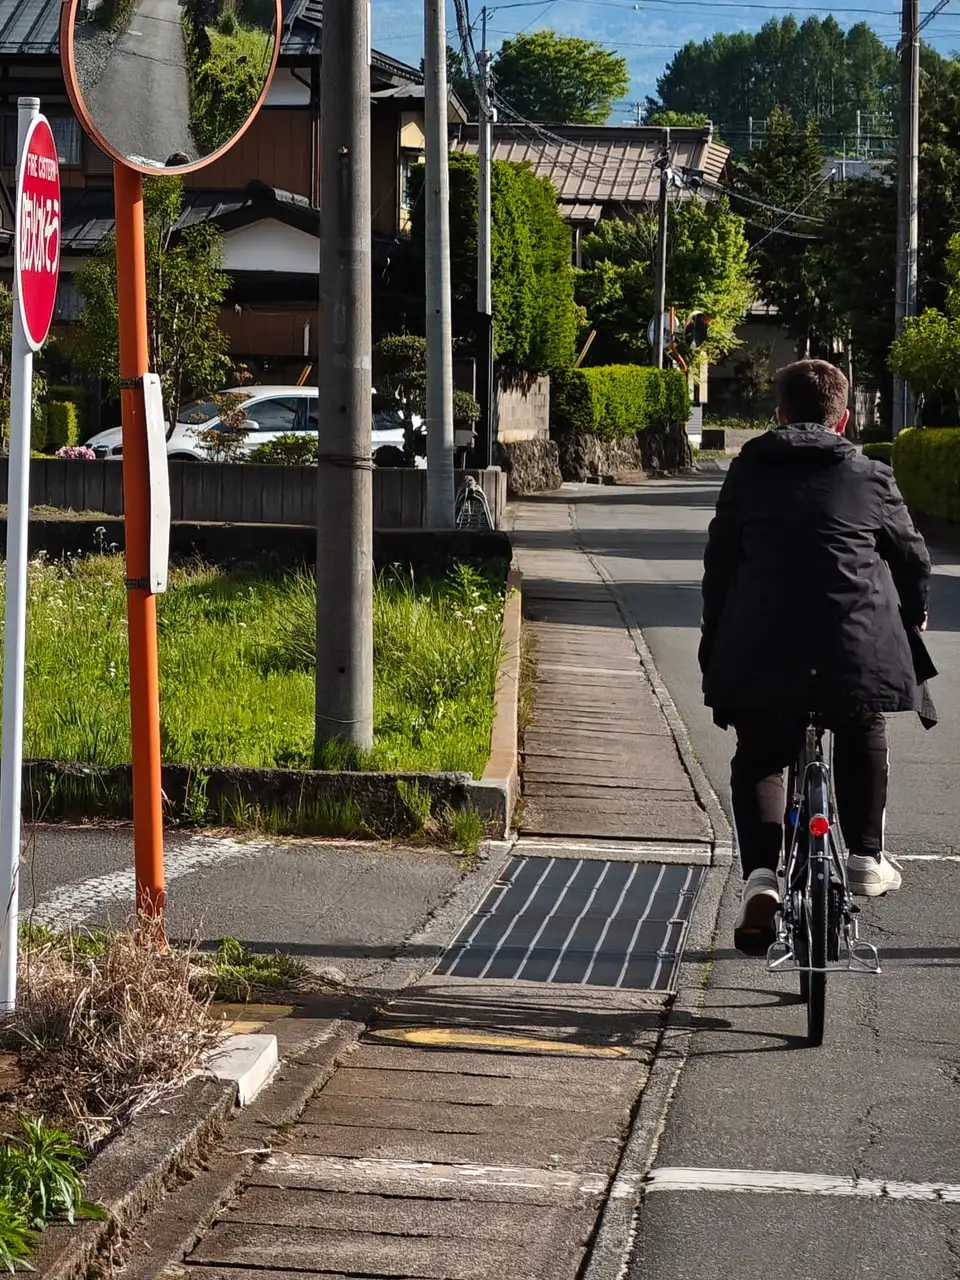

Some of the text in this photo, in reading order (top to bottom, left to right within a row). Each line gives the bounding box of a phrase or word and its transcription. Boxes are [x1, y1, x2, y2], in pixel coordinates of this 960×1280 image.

[27, 153, 57, 182] FIRE CISTERN
[21, 190, 59, 275] 防火水そう
